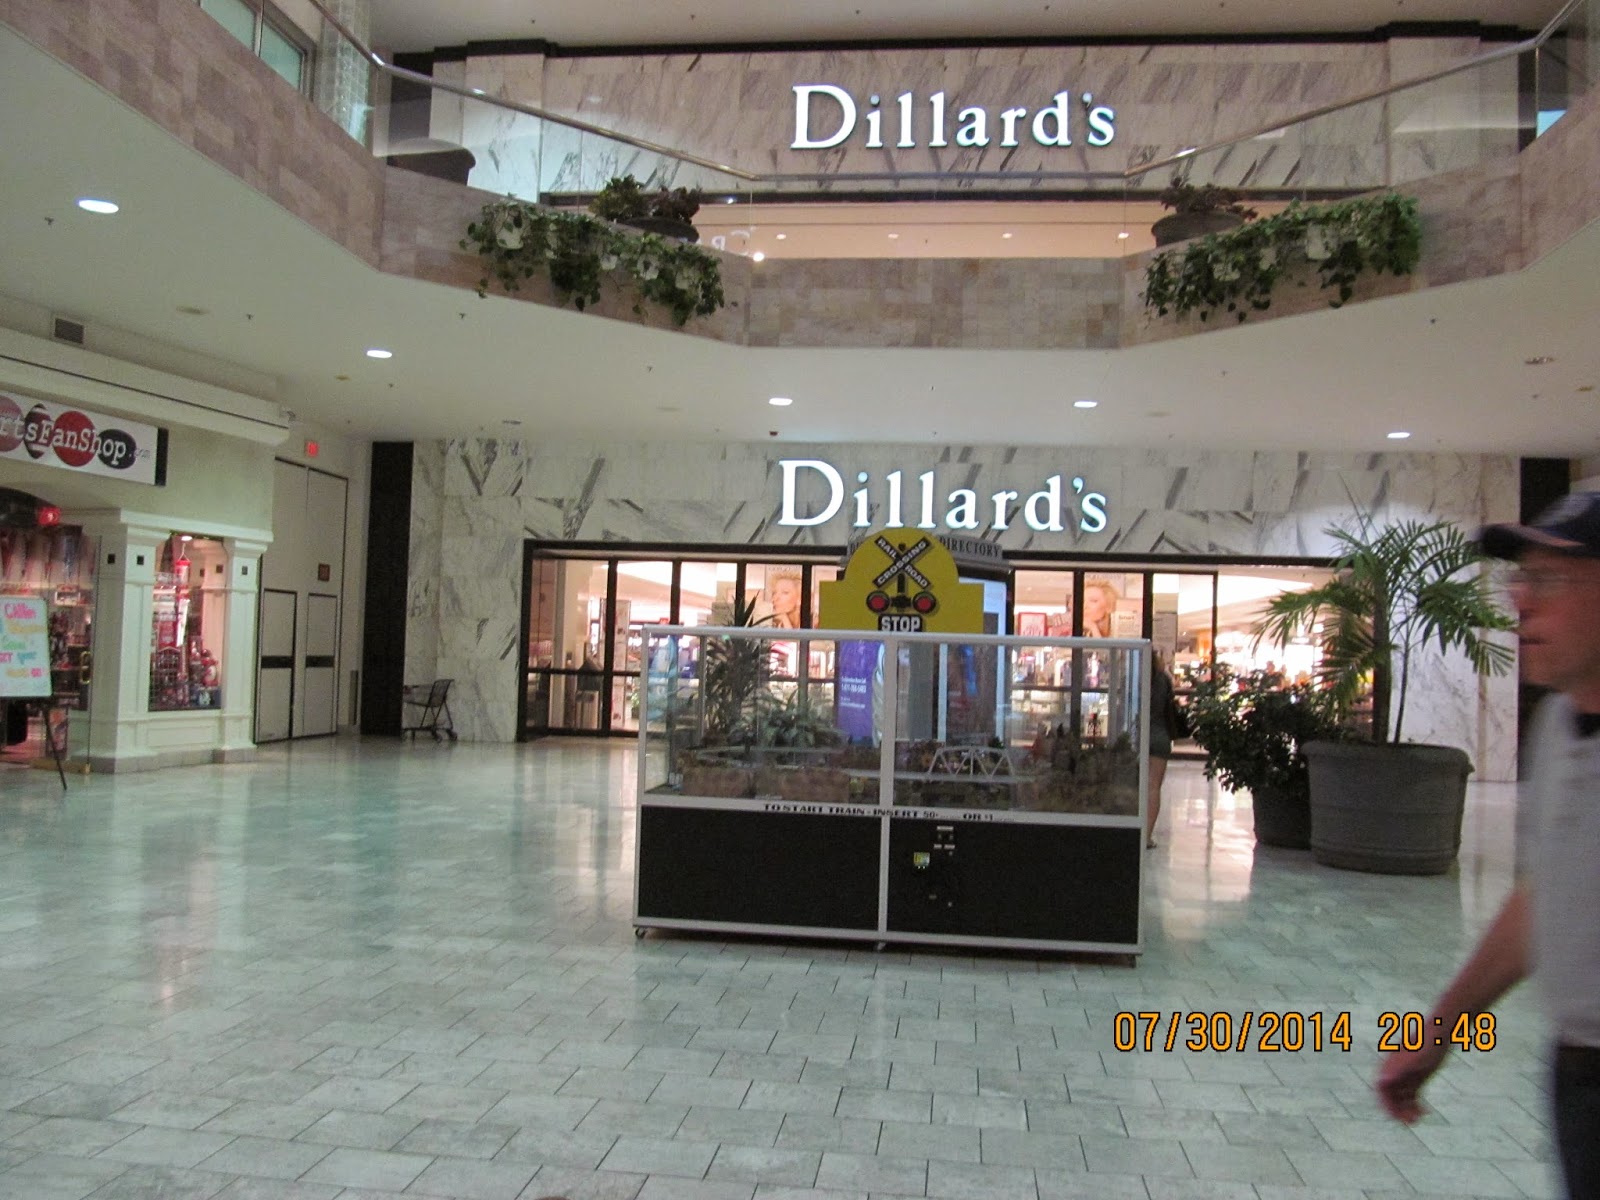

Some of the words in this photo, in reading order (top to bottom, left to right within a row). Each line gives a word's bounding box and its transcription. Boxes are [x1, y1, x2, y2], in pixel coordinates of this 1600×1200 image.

[790, 84, 1115, 150] Dillard's
[778, 459, 1107, 533] Dillard's
[877, 541, 927, 585] CROSSING
[877, 539, 897, 558] RAIL
[905, 564, 929, 588] ROAD
[940, 536, 1000, 557] DIRECTORY
[881, 616, 921, 632] STOP
[783, 804, 823, 813] START
[829, 806, 865, 815] TRAIN
[873, 808, 918, 817] INSERT
